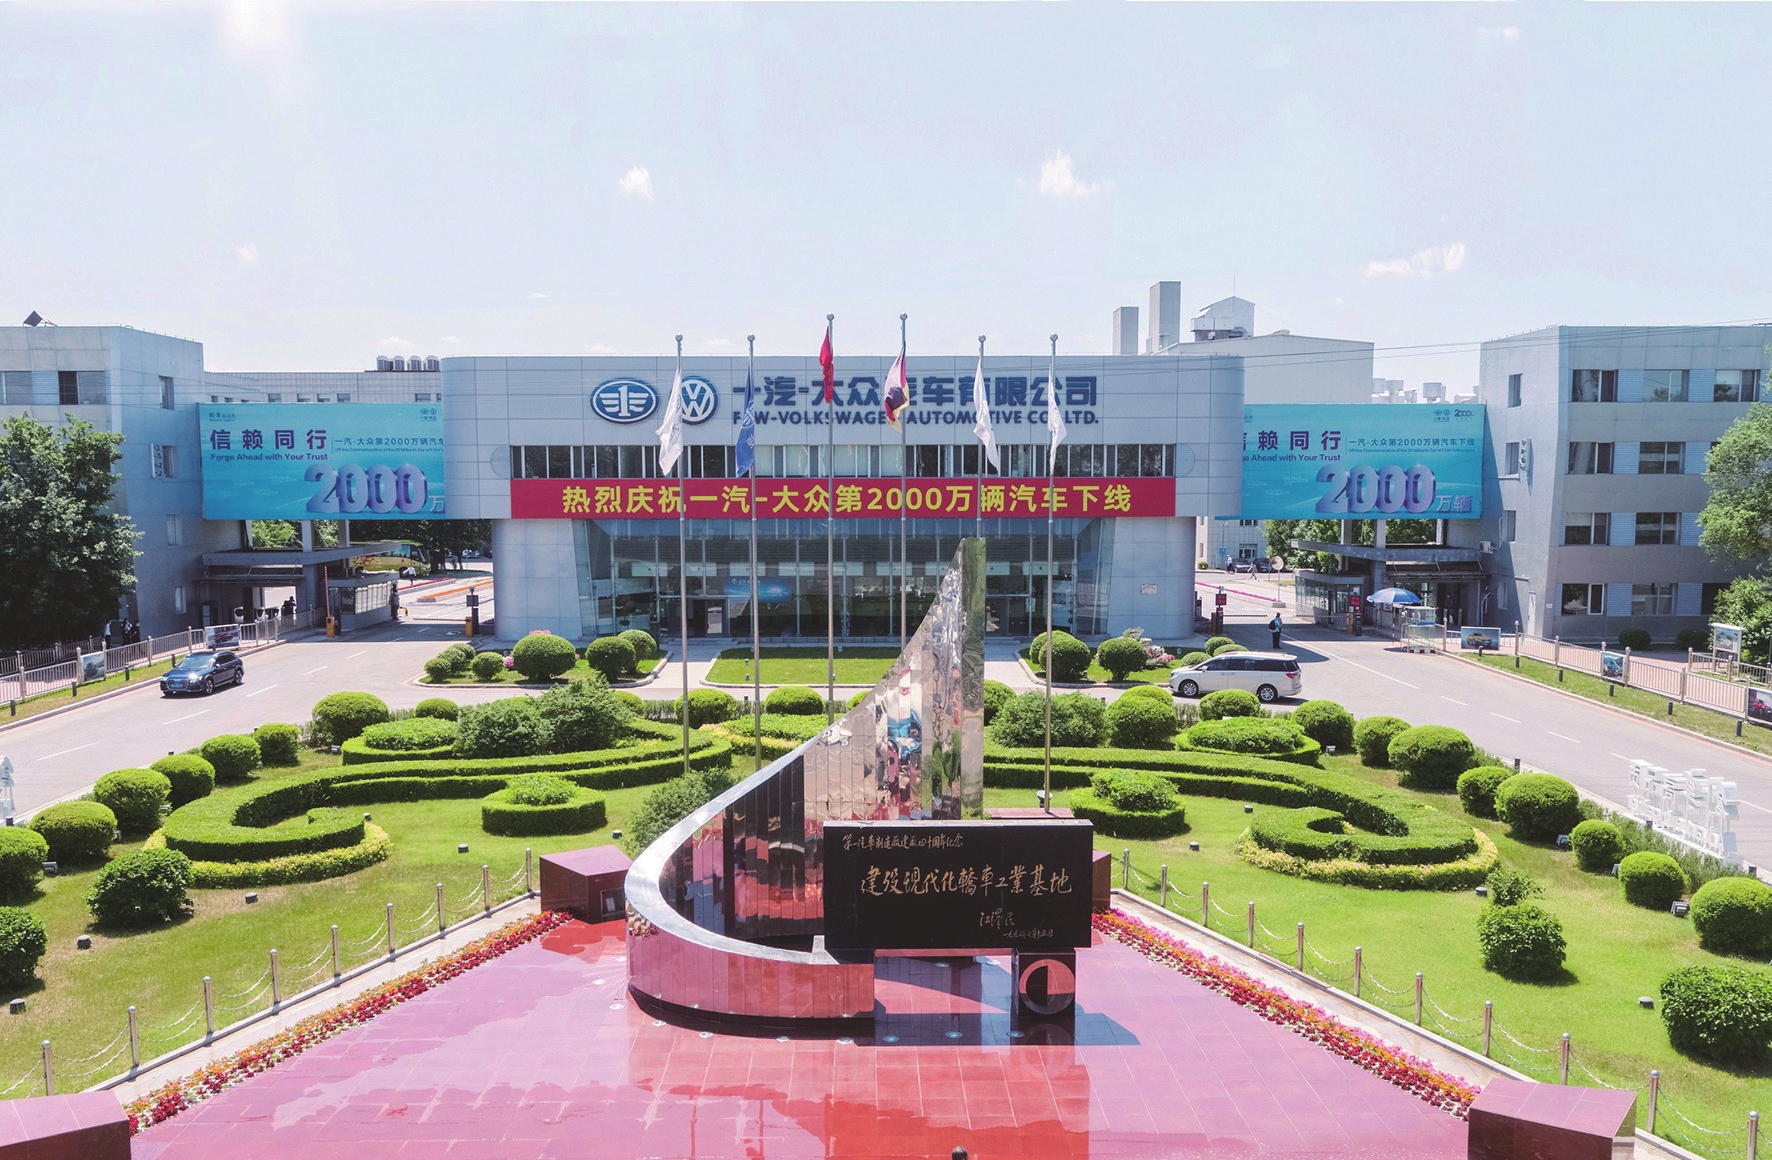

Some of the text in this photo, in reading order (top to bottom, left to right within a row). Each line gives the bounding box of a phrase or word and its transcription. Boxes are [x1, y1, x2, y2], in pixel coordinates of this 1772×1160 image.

[210, 429, 327, 450] 信赖同行
[211, 453, 234, 462] Forge
[562, 485, 1132, 513] 热烈庆祝一汽-大众第2000万辆汽车下线
